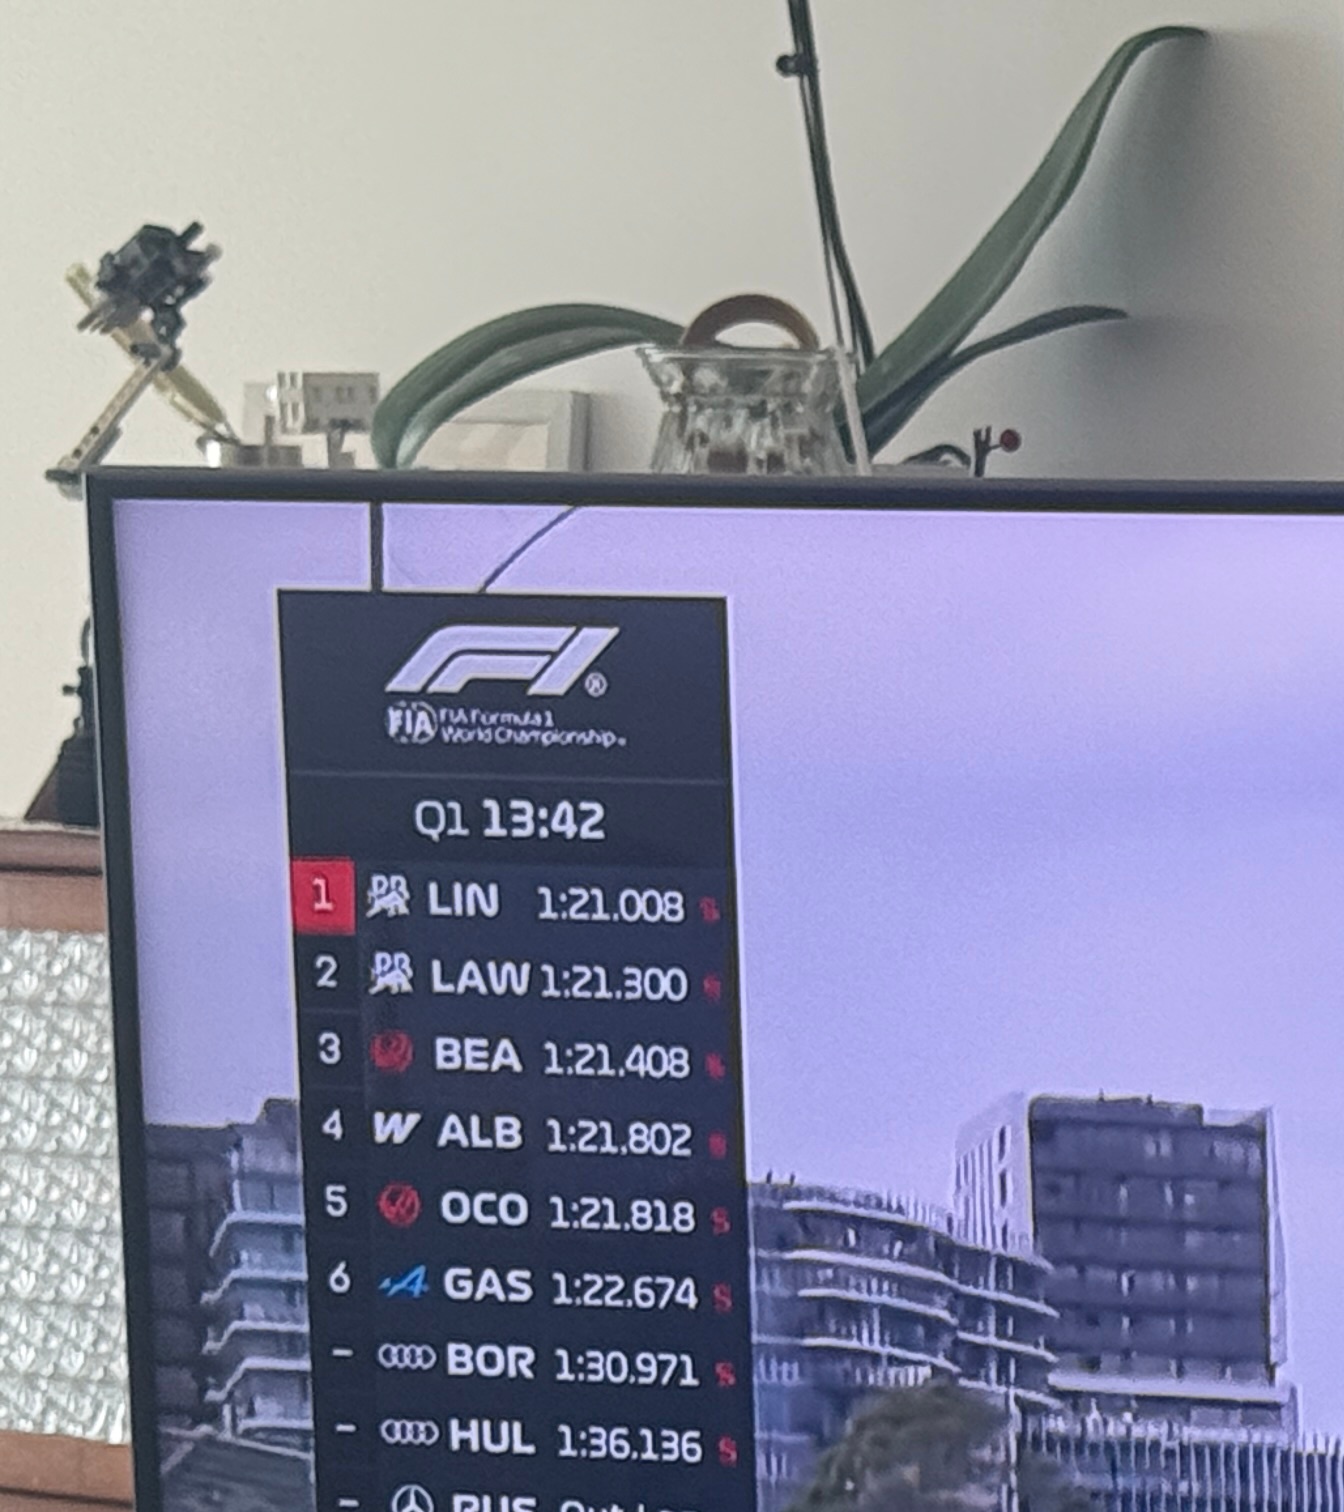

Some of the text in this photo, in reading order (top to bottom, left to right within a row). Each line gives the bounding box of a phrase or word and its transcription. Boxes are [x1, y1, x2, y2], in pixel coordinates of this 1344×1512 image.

[415, 800, 606, 842] Q1 13:42
[312, 877, 333, 913] 1
[428, 882, 498, 917] LIN
[537, 887, 684, 922] 1:21.008
[314, 955, 338, 988] 2
[432, 960, 530, 995] LAW
[541, 965, 687, 1001] 1:21.300
[319, 1033, 341, 1064] 3
[435, 1038, 522, 1072] BEA
[544, 1043, 690, 1078] 1:21.408
[322, 1109, 343, 1140] 4
[438, 1116, 523, 1150] ALB
[546, 1119, 693, 1157] 1:21.802
[325, 1185, 347, 1216] 5
[440, 1192, 528, 1226] OCO
[550, 1196, 696, 1233] 1:21.818
[329, 1262, 350, 1294] 6
[444, 1267, 533, 1301] GAS
[552, 1274, 698, 1310] 1:22.674
[446, 1343, 535, 1379] BOR
[555, 1349, 699, 1387] 1:30.971
[449, 1419, 535, 1454] HUL
[557, 1425, 702, 1463] 1:36.136
